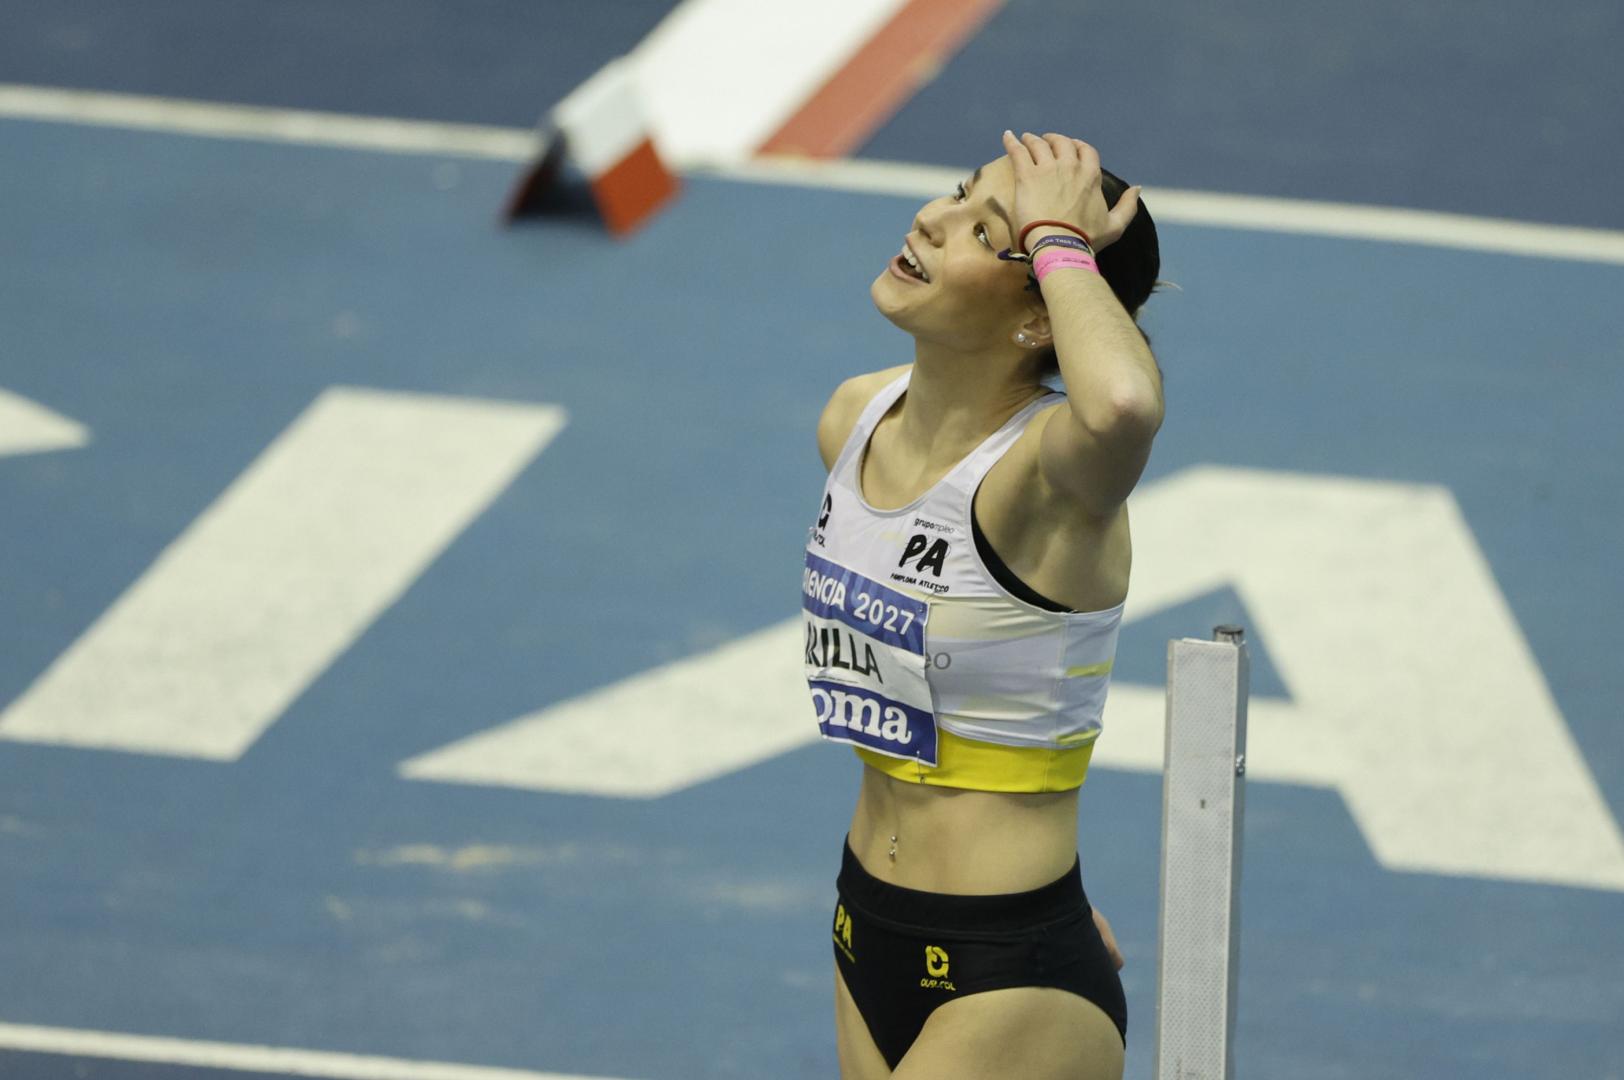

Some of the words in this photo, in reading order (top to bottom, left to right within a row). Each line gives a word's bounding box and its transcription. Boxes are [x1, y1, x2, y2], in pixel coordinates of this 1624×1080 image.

[899, 534, 949, 577] PA
[890, 573, 917, 585] PAMPLONA
[854, 592, 915, 635] 2027
